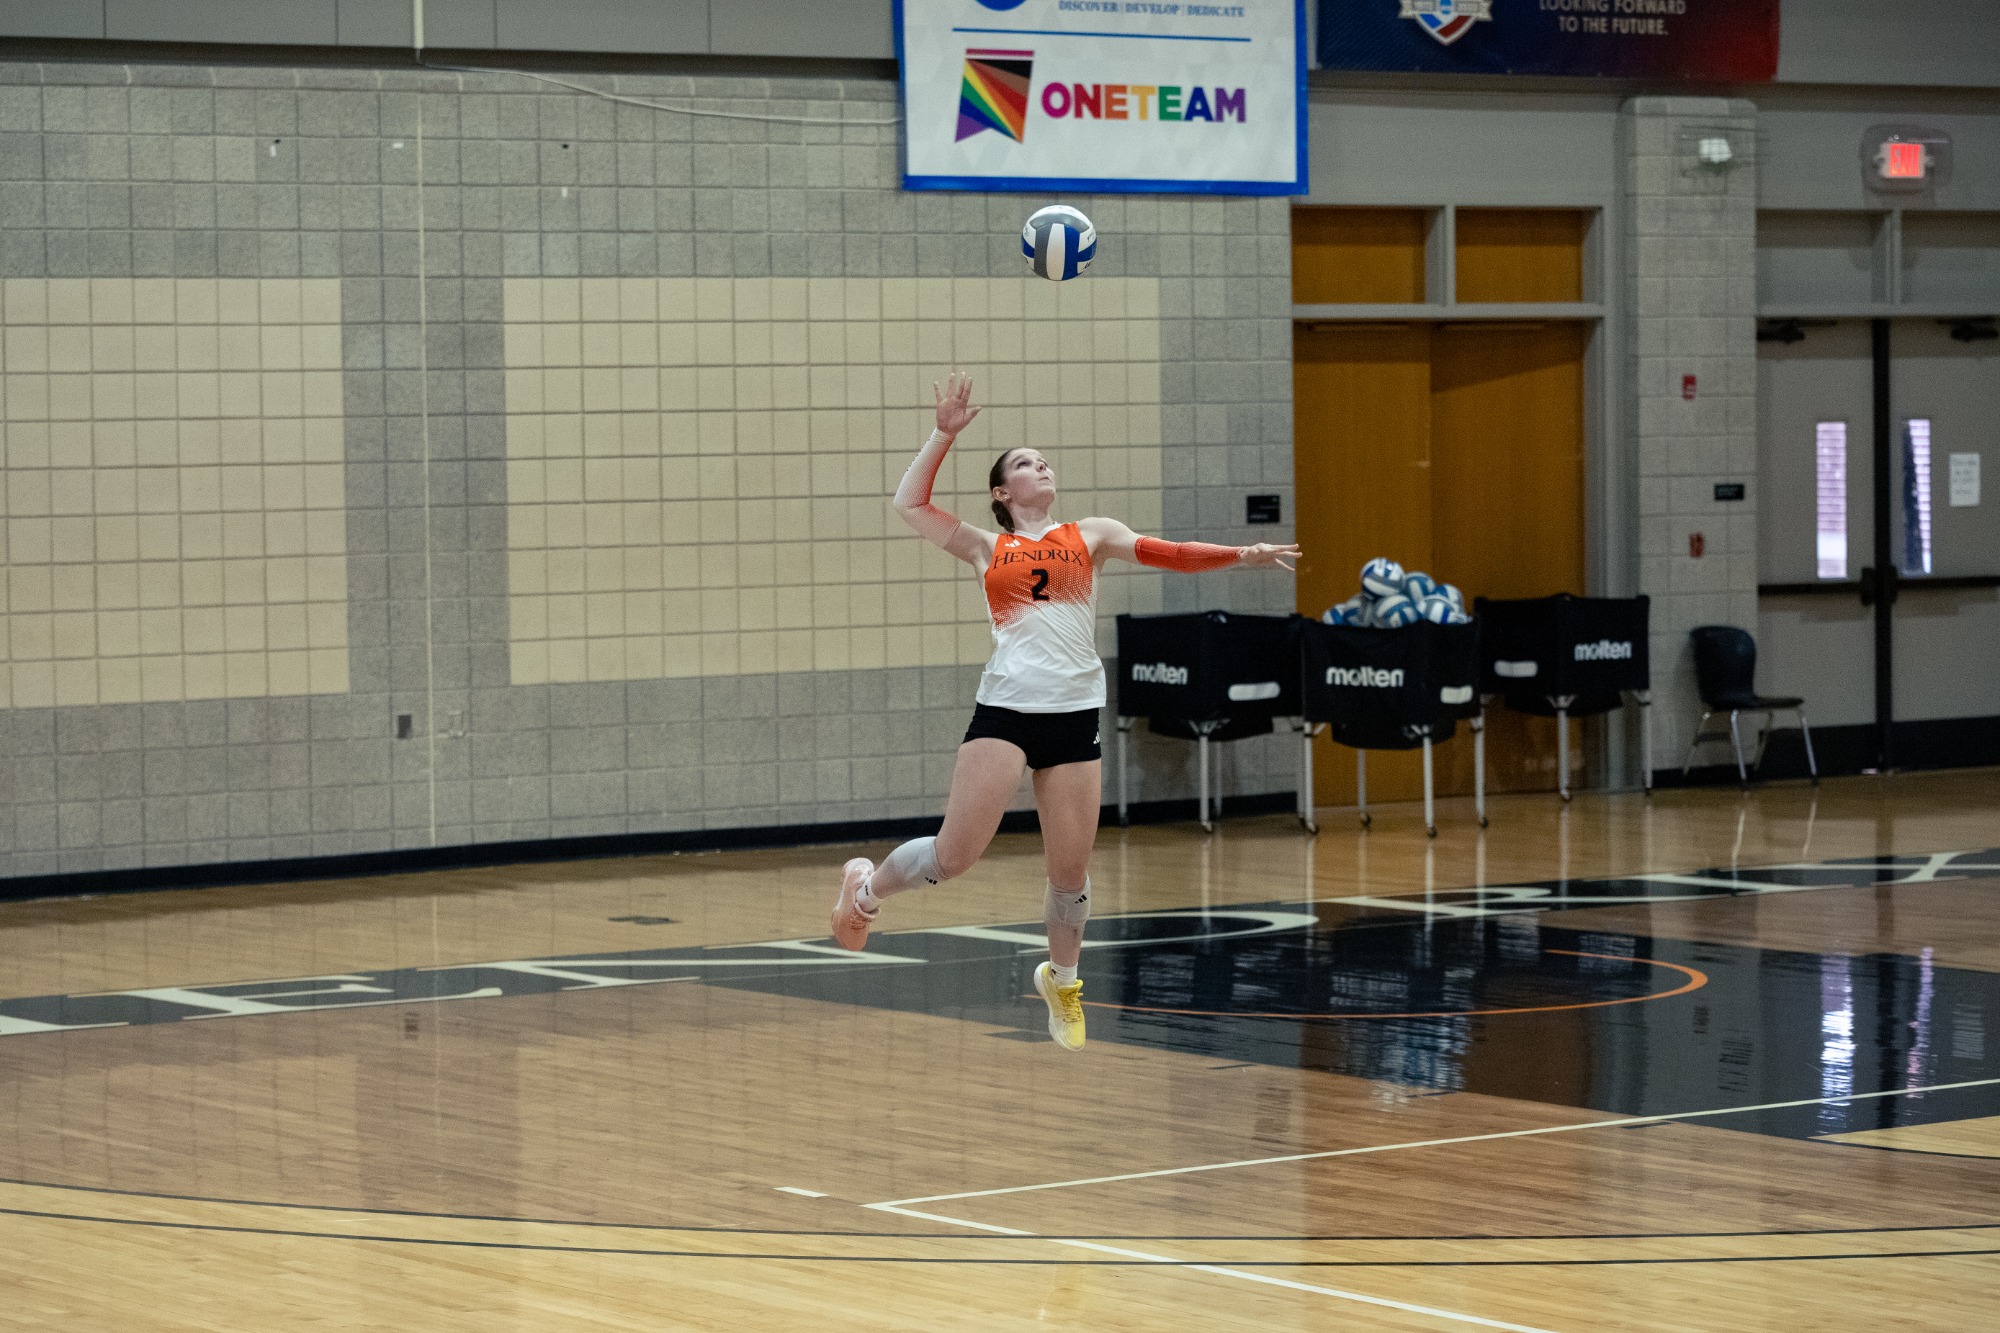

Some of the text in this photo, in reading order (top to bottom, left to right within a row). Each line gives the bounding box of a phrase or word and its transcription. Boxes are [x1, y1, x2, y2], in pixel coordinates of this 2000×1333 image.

[1539, 0, 1686, 14] LOOKING FORWARD
[1559, 15, 1670, 35] TO THE FUTURE.
[1040, 82, 1247, 124] ONETEAM
[992, 549, 1083, 570] HENDRIX
[1031, 568, 1050, 601] 2
[1573, 639, 1632, 661] molten
[1132, 661, 1188, 686] molten
[1326, 666, 1404, 688] molten
[0, 852, 2000, 1035] ENDRIX
